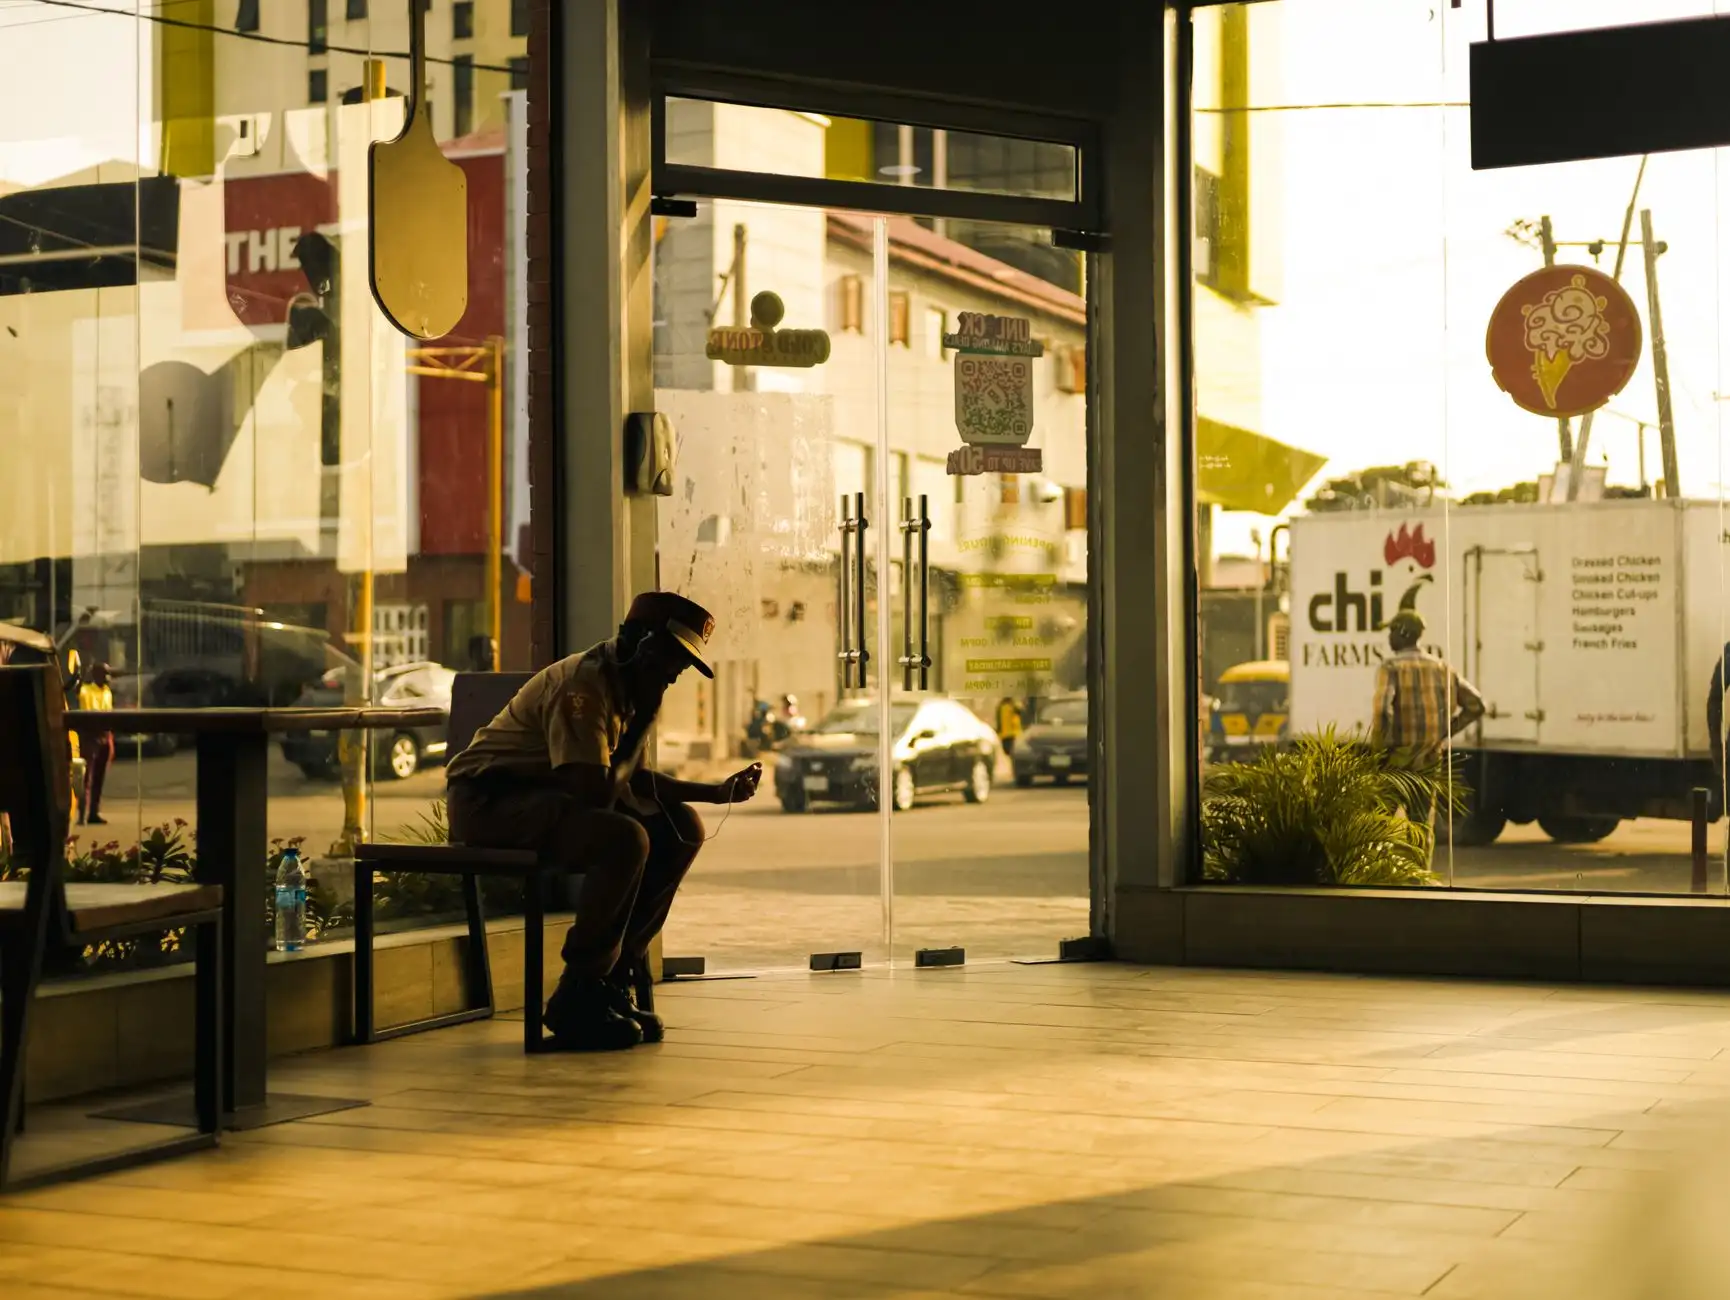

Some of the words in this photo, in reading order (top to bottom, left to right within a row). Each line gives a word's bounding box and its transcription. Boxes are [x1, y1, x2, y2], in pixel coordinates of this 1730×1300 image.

[225, 226, 301, 275] THE
[1617, 556, 1661, 566] Chicken
[1616, 572, 1660, 583] Chicken
[1308, 570, 1383, 632] chi
[1571, 590, 1614, 600] Chicken
[1572, 606, 1635, 618] Hamburgers
[1303, 642, 1384, 667] FARMS
